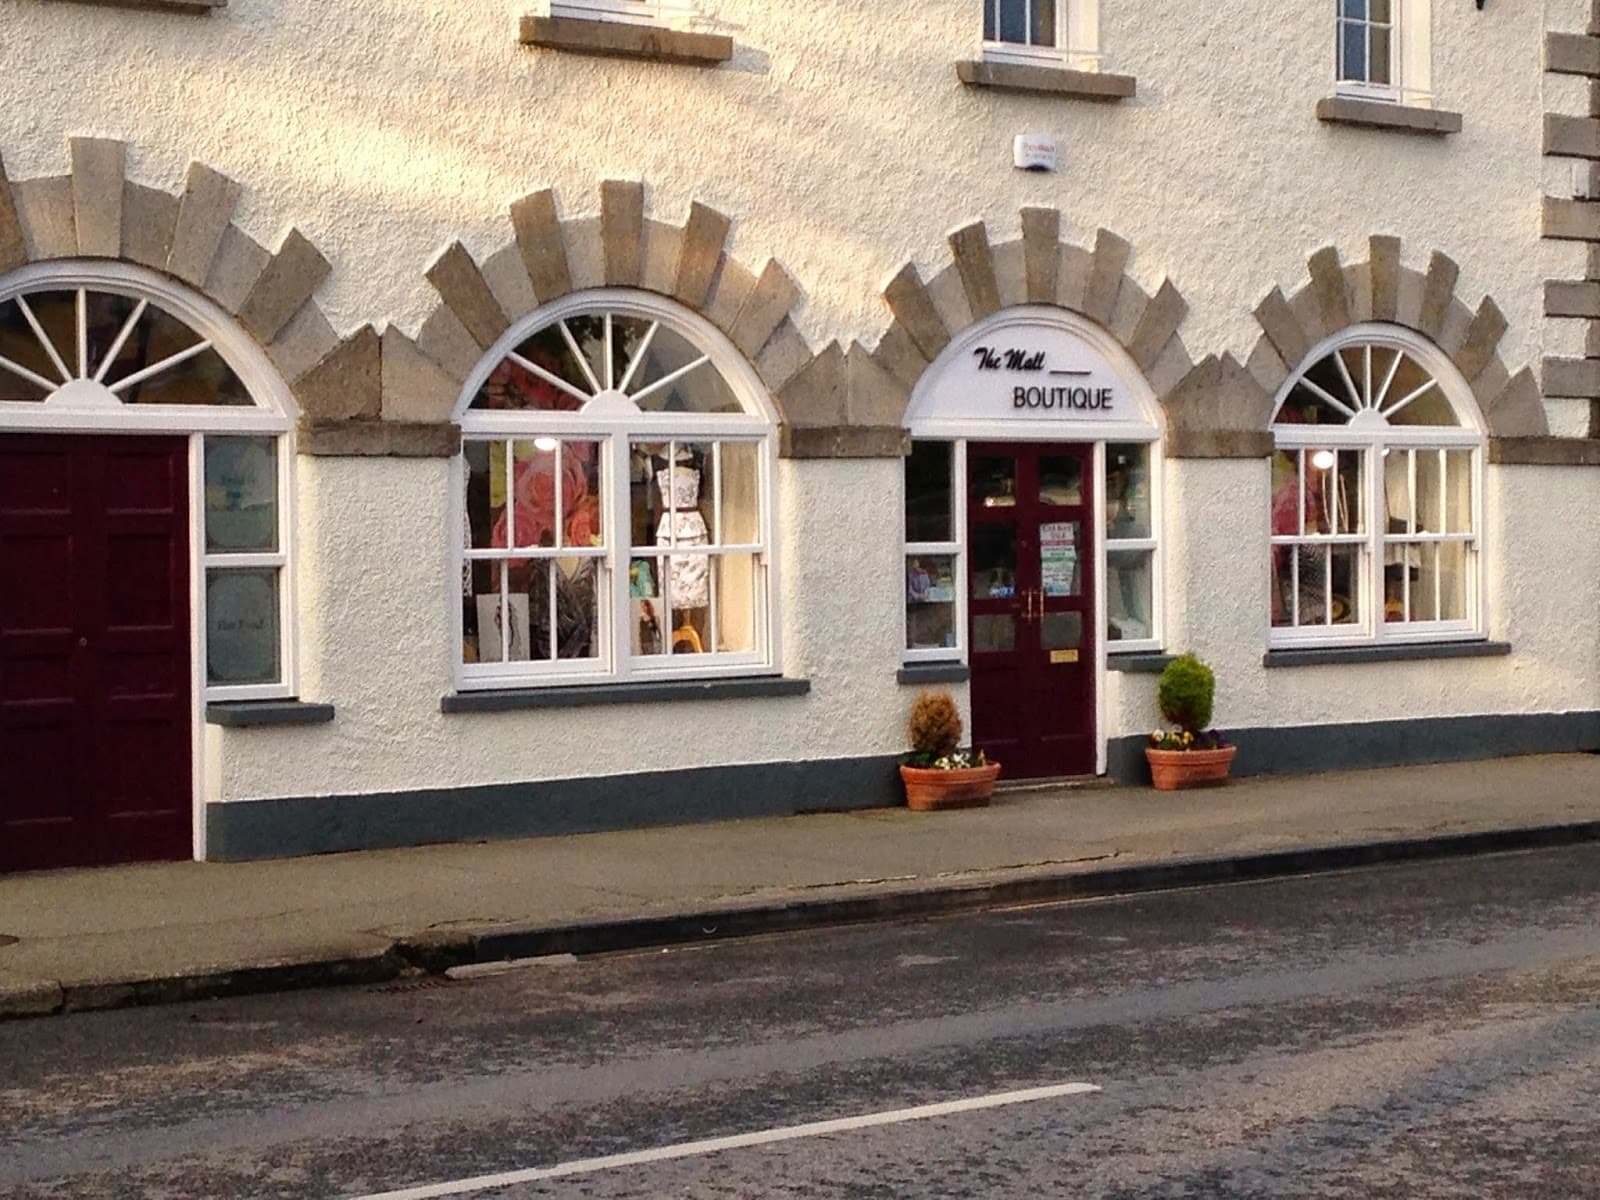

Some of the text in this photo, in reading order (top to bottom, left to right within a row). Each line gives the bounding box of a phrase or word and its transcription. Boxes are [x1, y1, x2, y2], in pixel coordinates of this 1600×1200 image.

[974, 347, 1046, 371] The Mall
[1013, 386, 1113, 409] BOUTIQUE
